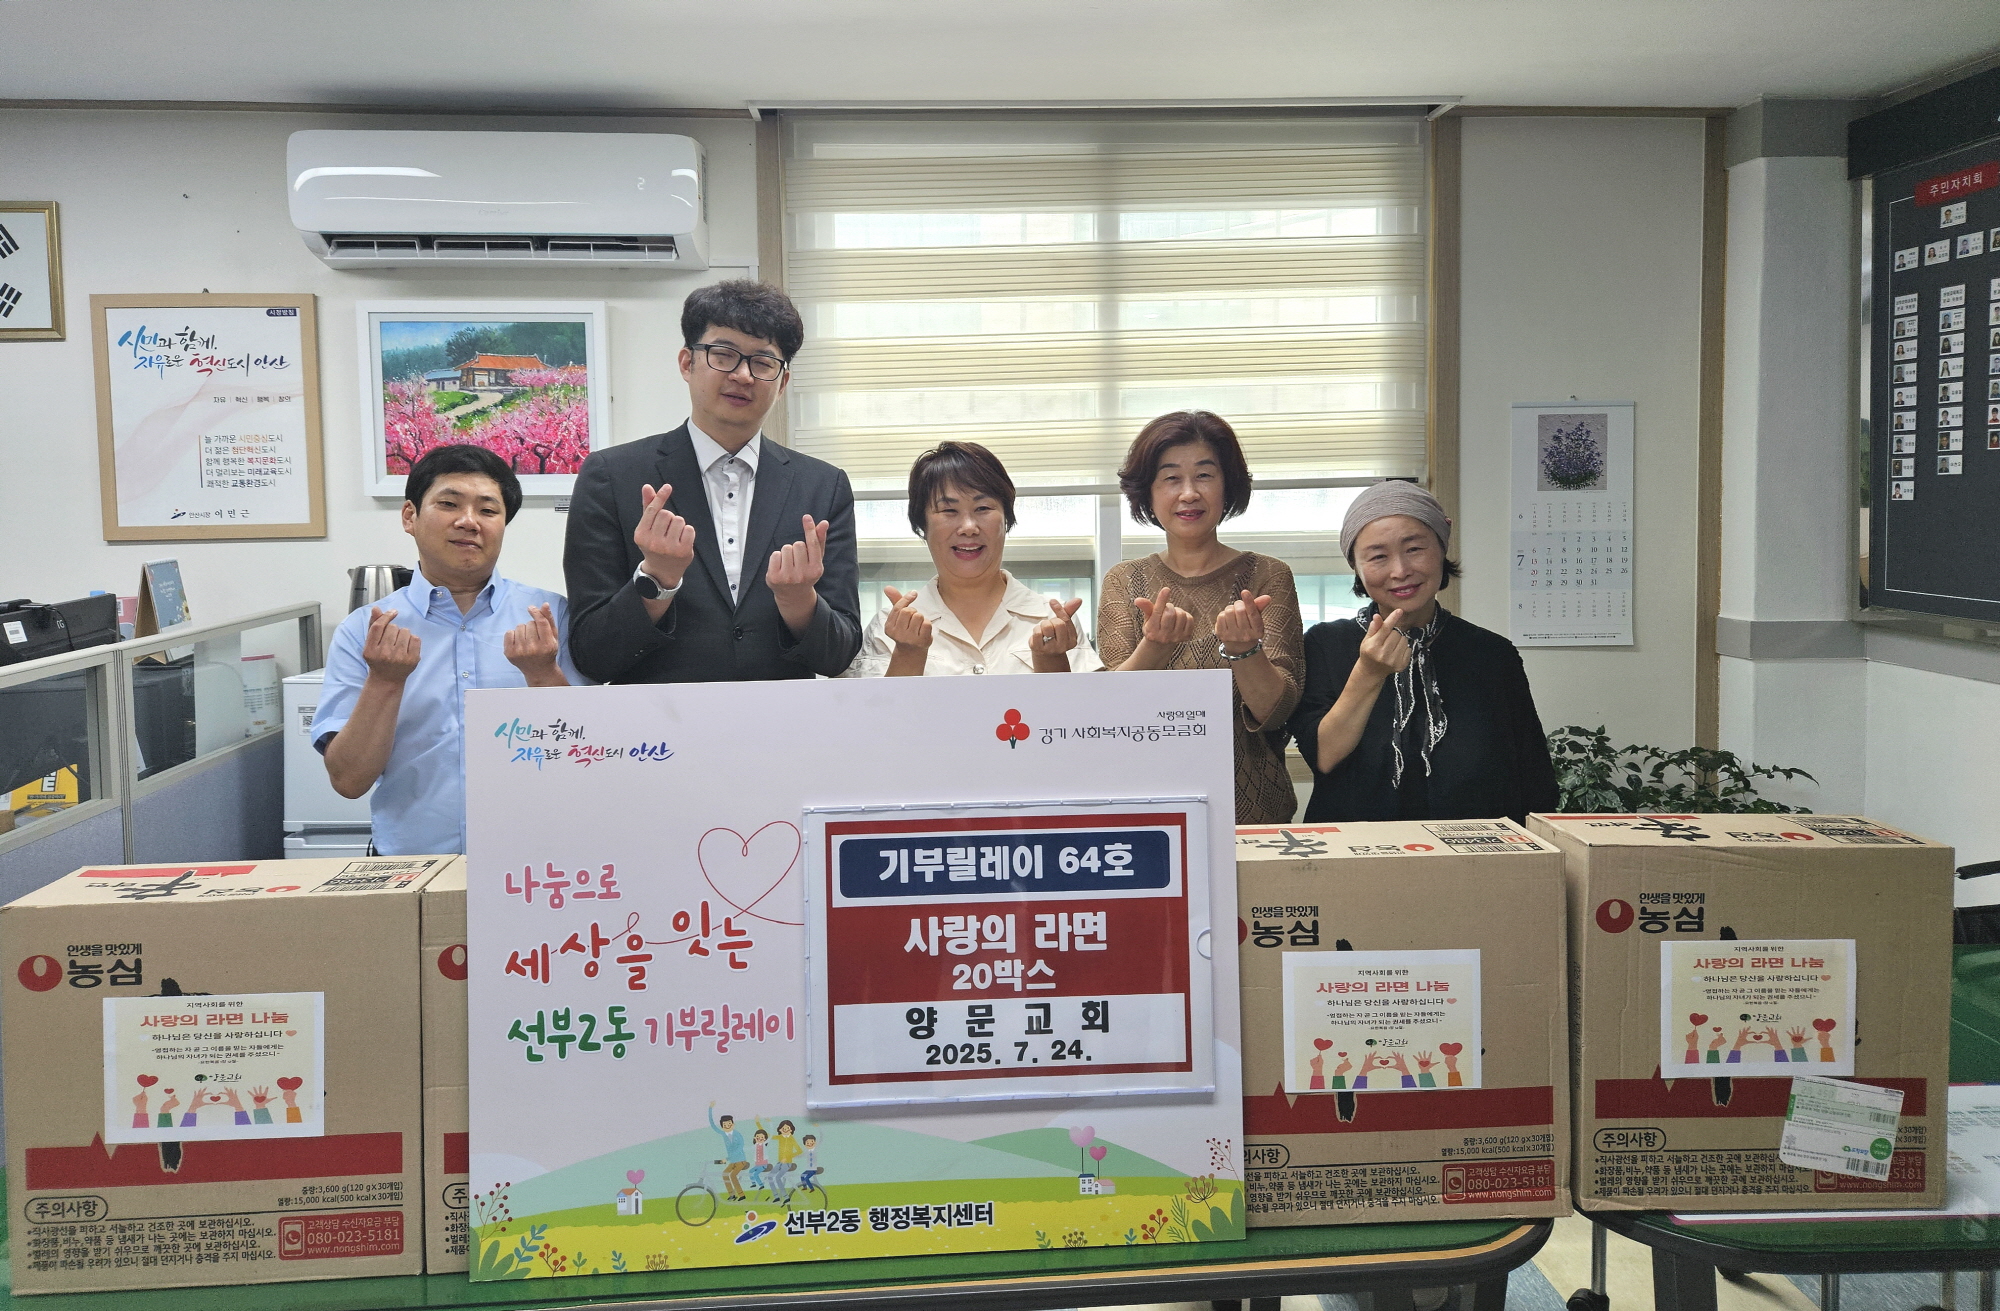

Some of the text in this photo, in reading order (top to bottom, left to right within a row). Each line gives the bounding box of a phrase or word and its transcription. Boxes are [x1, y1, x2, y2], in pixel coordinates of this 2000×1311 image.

[1929, 171, 1983, 198] 주민자치회
[118, 325, 217, 358] 시민과 함께.
[134, 353, 292, 380] 자유로운 혁신도시 안산
[204, 434, 283, 443] 늘 가까운 시민중심도시
[205, 446, 276, 455] 더 젊은 첨단혁신도시
[205, 456, 292, 466] 함께 행복한 복지문화도시
[206, 467, 292, 477] 더 멀리보는 미래교육도시
[206, 479, 276, 488] 쾌적한 교통환경도시
[1517, 555, 1525, 566] 7
[494, 717, 585, 749] 시민과 함께.
[1039, 723, 1207, 745] 경기 사회복지공동모금회
[510, 742, 675, 771] 자유로운 혁신도시 안산
[879, 841, 1135, 884] 기부릴레이 64호
[504, 861, 622, 910] 나눔으로
[1639, 892, 1705, 904] 인생을 맛있게
[1251, 905, 1319, 918] 인생을 맛있게
[1638, 906, 1705, 934] 농심
[903, 911, 1108, 957] 사랑의 라면
[1251, 920, 1320, 948] 농심
[66, 942, 143, 957] 인생을 맛있게
[504, 900, 754, 992] 세상을 잇는
[1693, 957, 1825, 969] 사랑의 라면 나눔
[66, 957, 144, 990] 농심
[952, 959, 1057, 992] 20박스
[1703, 974, 1819, 983] 하나님은 당신을 사랑하십니다
[1316, 980, 1450, 994] 사랑의 라면 나눔
[187, 1001, 226, 1009] 지역사회를
[1326, 997, 1444, 1007] 하나님은 당신을 사랑하십니다
[140, 1011, 289, 1028] 사랑의 라면 나눔
[152, 1030, 283, 1041] 하나님은 당신을 사랑하십니다
[507, 1004, 796, 1063] 선부2동 기부릴레이
[925, 1038, 1092, 1065] 2025. 7. 24.
[1499, 1136, 1520, 1145] g(120
[1602, 1131, 1658, 1149] 주의사항
[1481, 1146, 1511, 1154] kcal(500
[1599, 1153, 1742, 1165] 직사광선을 피하고 서늘하고 건조한 곳에
[1467, 1165, 1551, 1177] 고객상담 수신자요금 부담
[1599, 1163, 1776, 1176] 화장품,비누,약품 등 냄새가 나는 곳에는 보관하지
[1467, 1176, 1551, 1190] 080-023-5181
[1599, 1173, 1799, 1186] 벌레의 영향을 받기 쉬우므로 깨끗한 곳에 보관하십시오.
[341, 1183, 364, 1194] g(120
[1468, 1188, 1552, 1200] www.nongshim.com
[1599, 1184, 1813, 1197] 제품이 파손될 우려가 있으니 절대 던지거나 충격을 주지 마십시오.
[322, 1193, 355, 1204] kcal(500
[34, 1199, 99, 1219] 주의사항
[307, 1216, 400, 1231] 고객상담 수신자요금 부담
[784, 1200, 995, 1235] 선부2동 행정복지센터
[307, 1228, 401, 1245] 080-023-5181
[307, 1241, 401, 1255] www.nongshim.com
